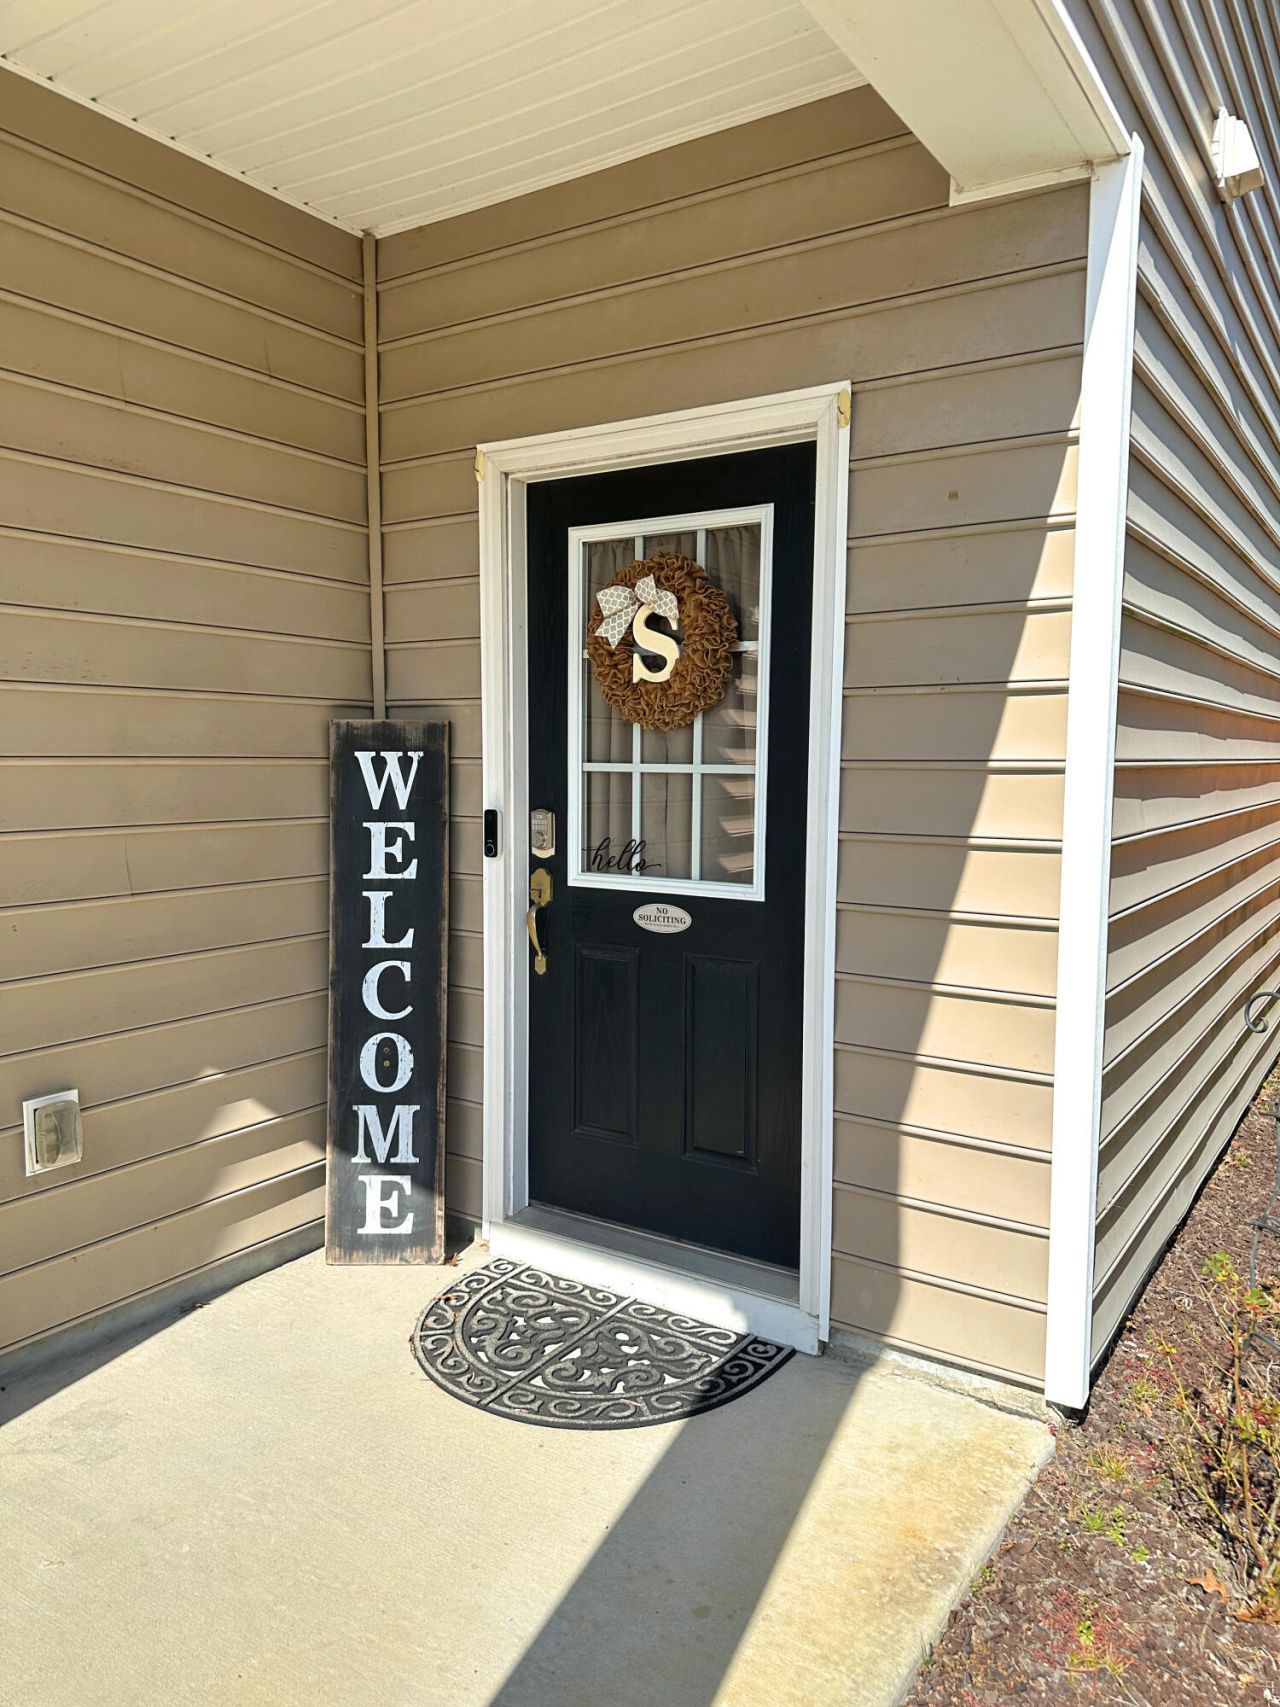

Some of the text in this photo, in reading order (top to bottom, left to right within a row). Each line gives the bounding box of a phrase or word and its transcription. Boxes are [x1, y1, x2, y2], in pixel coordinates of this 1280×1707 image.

[632, 604, 681, 684] S
[581, 836, 662, 872] hello
[638, 913, 686, 925] SOLICITING
[656, 906, 668, 915] NO
[351, 751, 425, 1235] WELCOME
